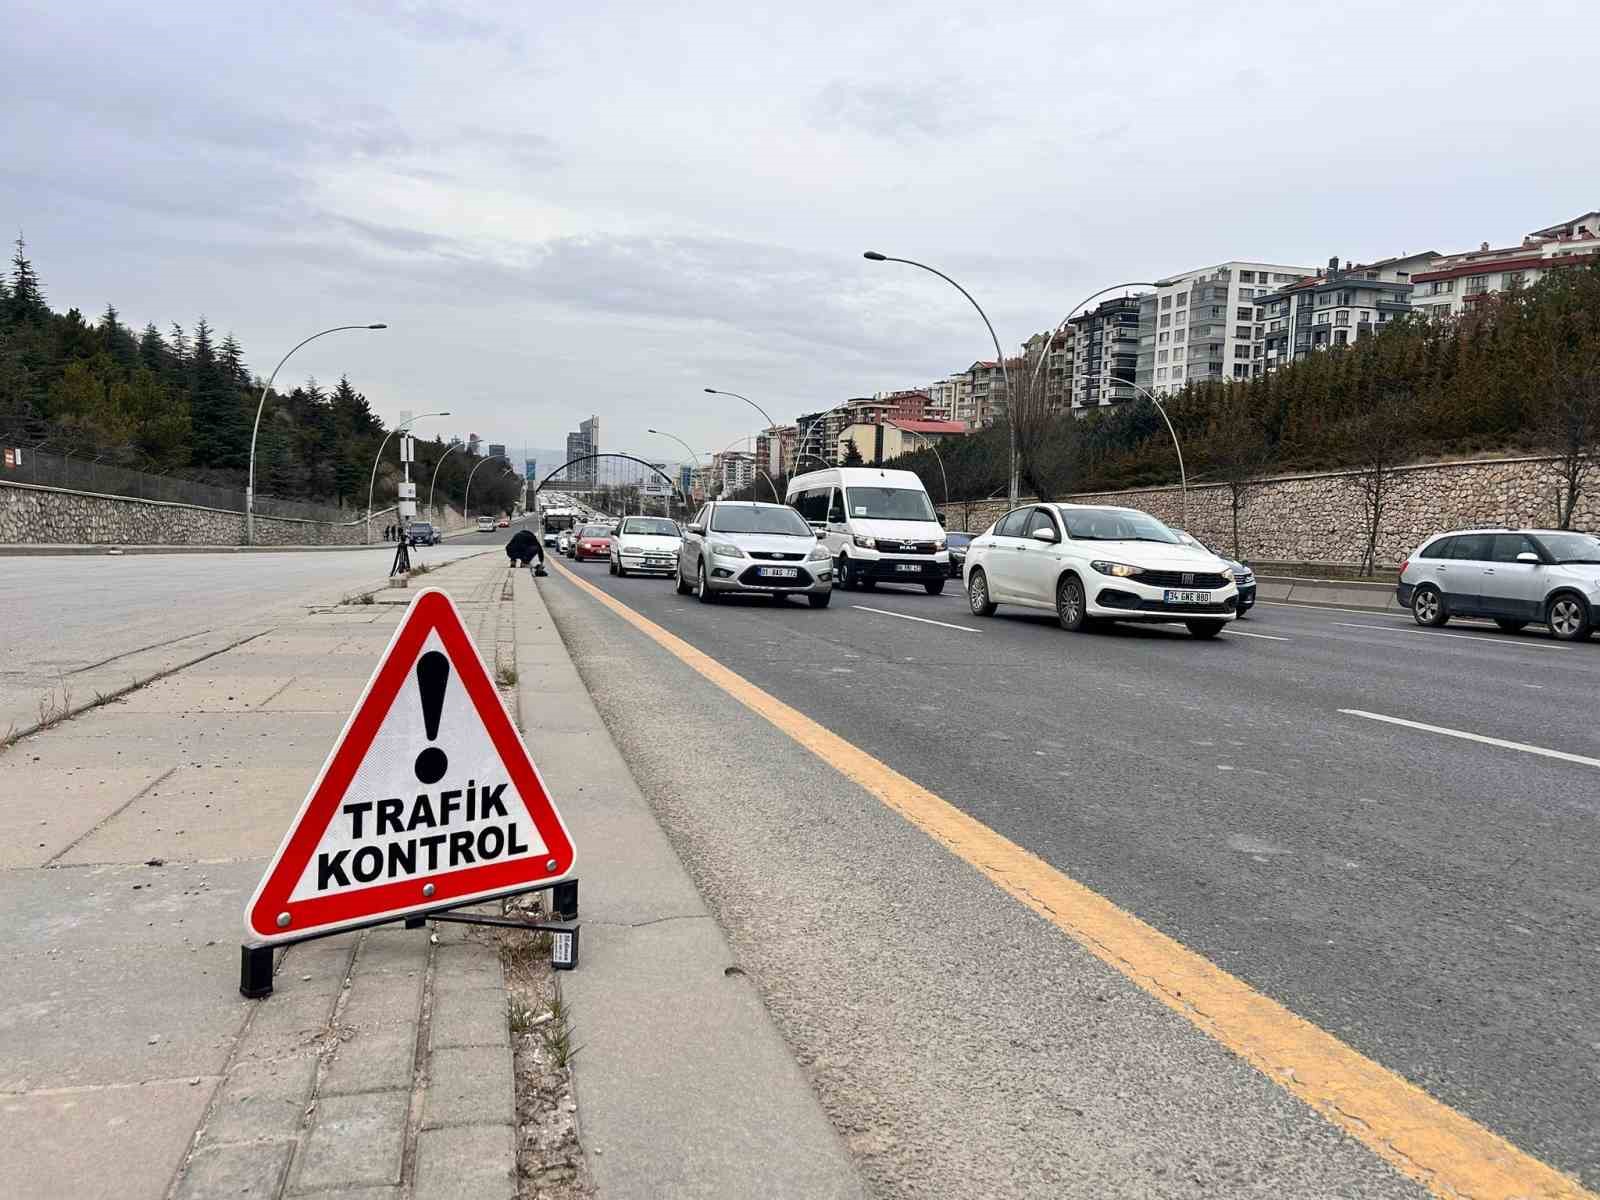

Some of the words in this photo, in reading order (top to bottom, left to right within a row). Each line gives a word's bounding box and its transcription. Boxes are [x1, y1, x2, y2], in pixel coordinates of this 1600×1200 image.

[1169, 592, 1178, 601] 34
[1181, 592, 1194, 601] GNE
[343, 779, 508, 840] TRAFİK
[317, 823, 528, 890] KONTROL
